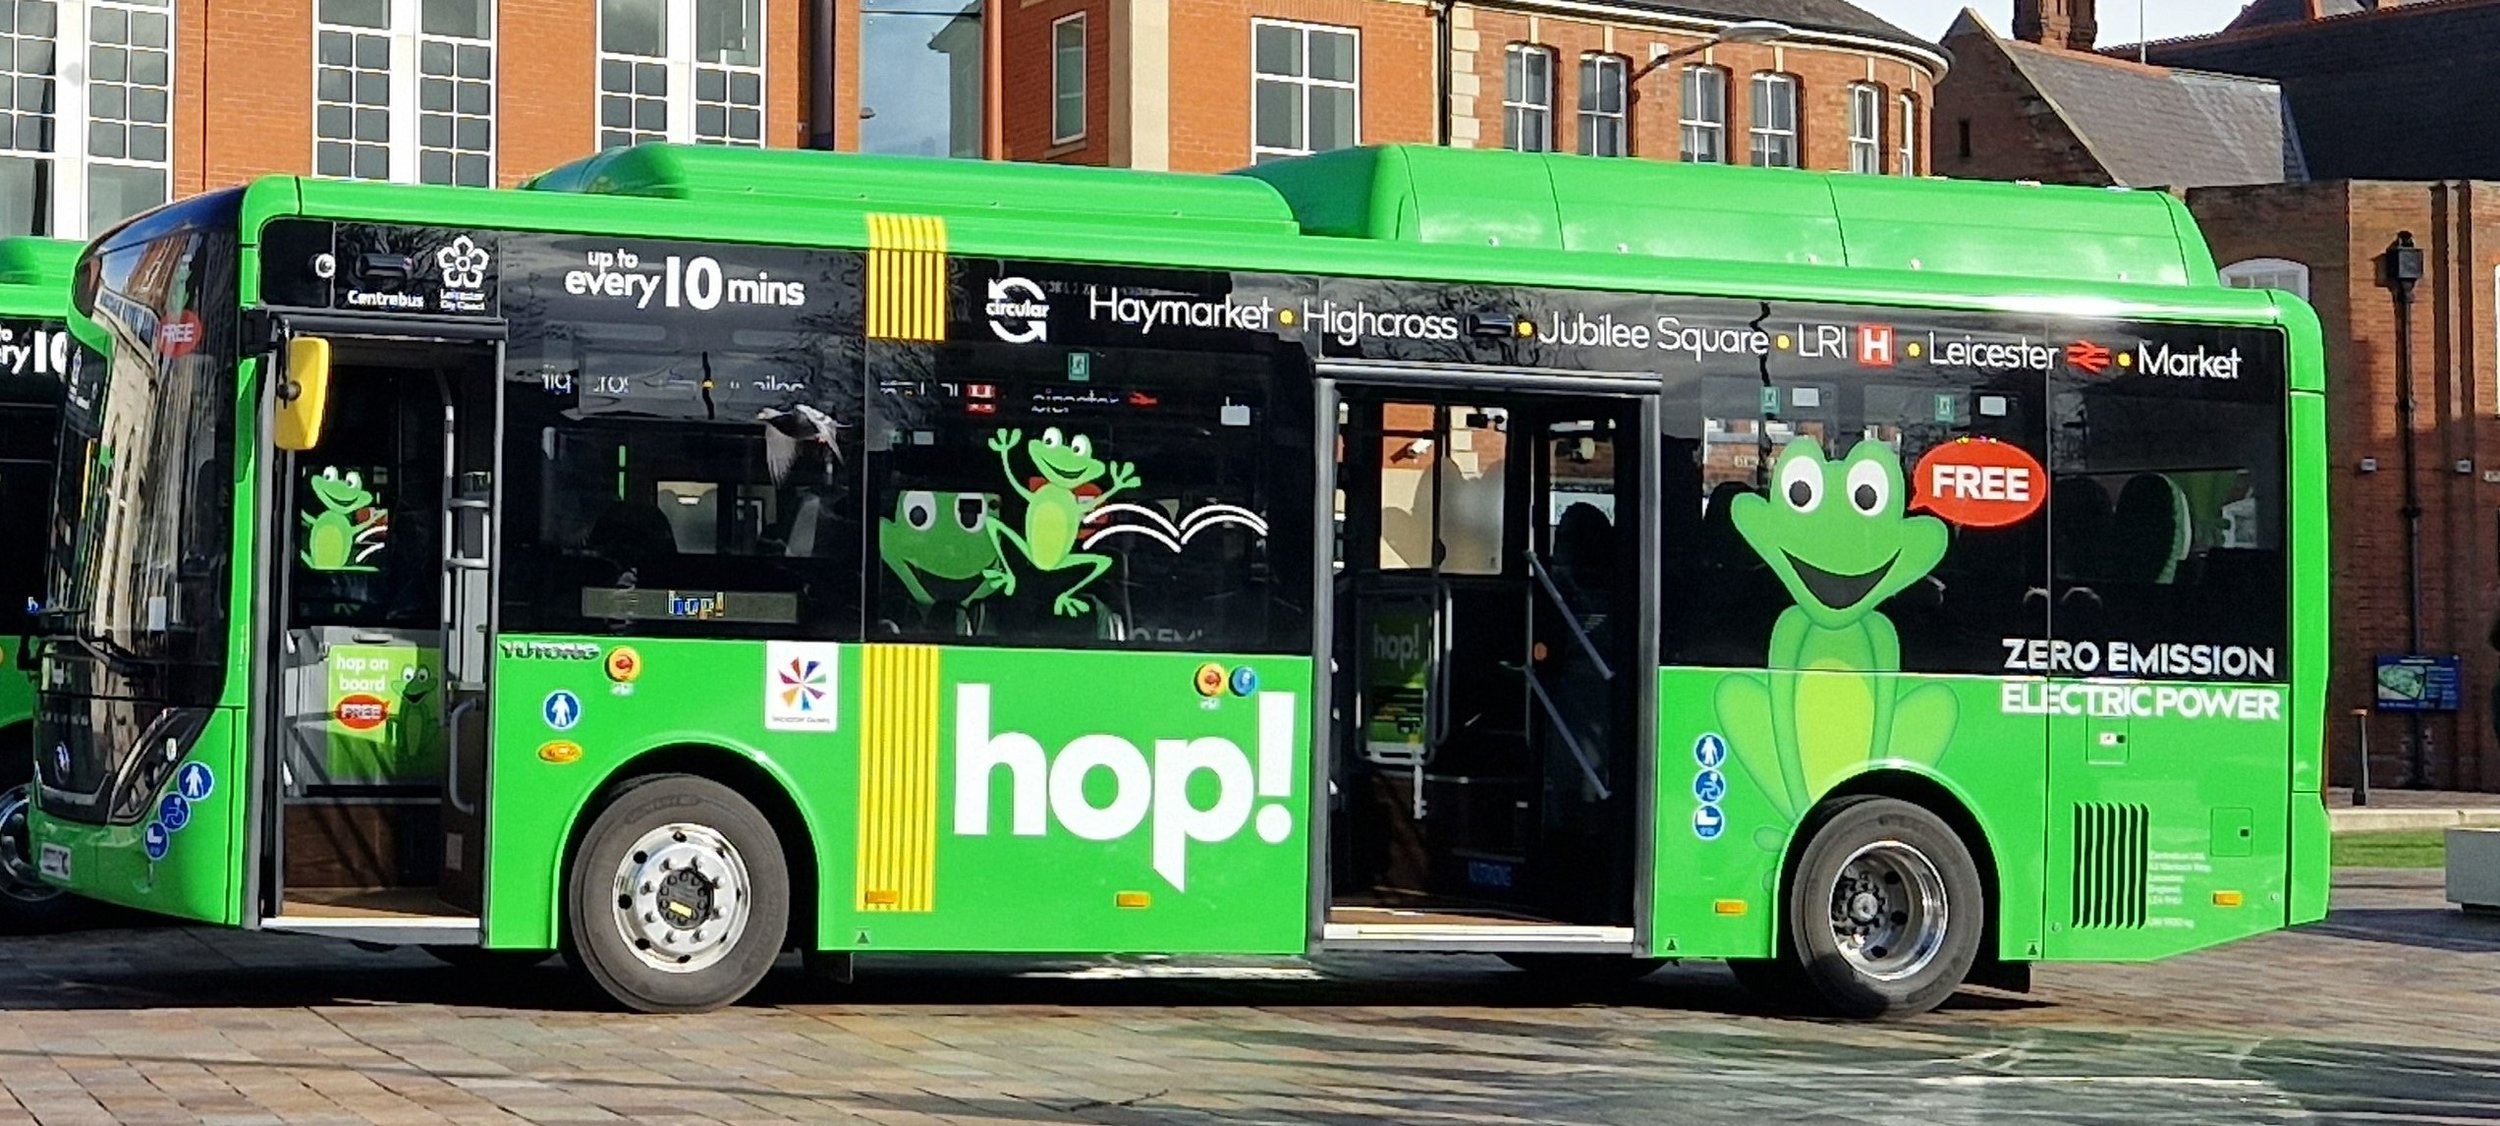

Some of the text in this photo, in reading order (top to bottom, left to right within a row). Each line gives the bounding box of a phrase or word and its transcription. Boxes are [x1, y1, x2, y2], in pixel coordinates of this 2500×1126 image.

[587, 249, 638, 270] up to
[564, 256, 806, 310] every 10 mins
[347, 289, 424, 308] Centrebus
[986, 301, 1049, 319] circular
[162, 323, 195, 343] FREE
[1089, 285, 2242, 379] Haymarket Highcross Jubilee Square LRI H Leicester Market
[1931, 463, 2030, 502] FREE
[499, 642, 600, 660] YUTONG
[1373, 622, 1420, 670] hop!
[2002, 638, 2274, 678] ZERO EMISSION
[336, 653, 389, 675] hop on
[339, 674, 386, 692] board
[2001, 683, 2281, 721] ELECTRIC POWER
[953, 683, 1296, 894] hop!
